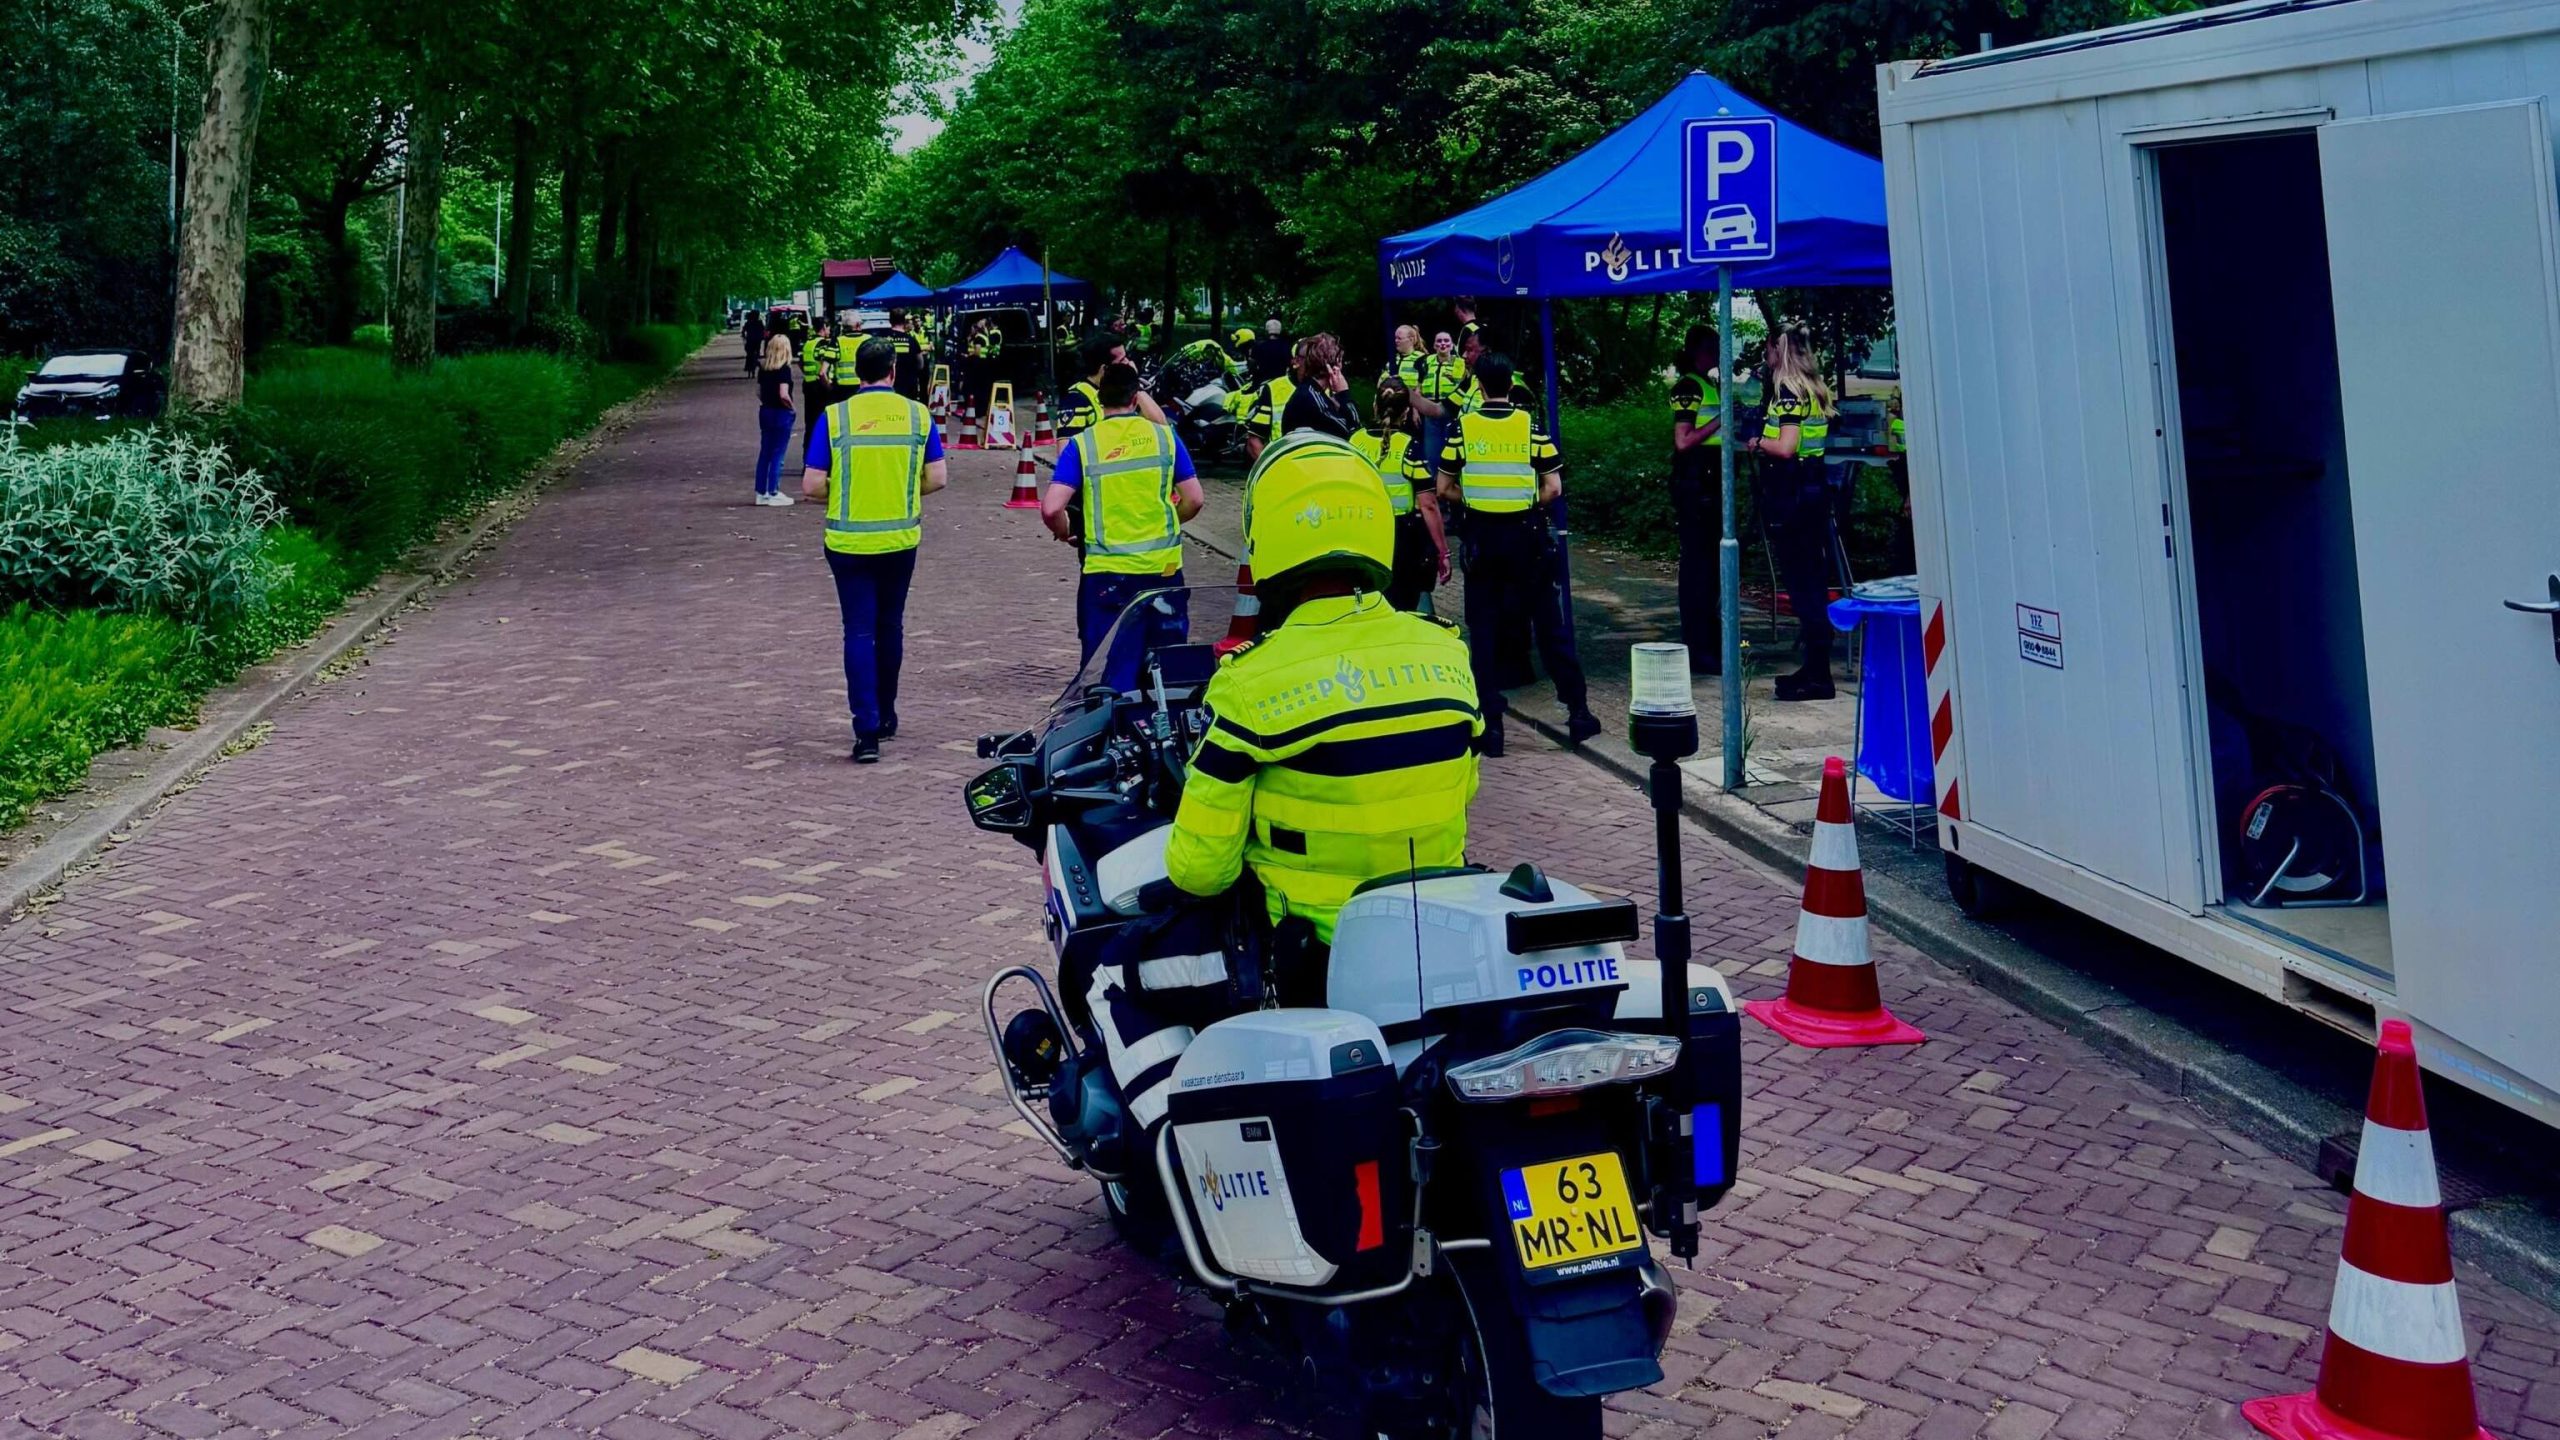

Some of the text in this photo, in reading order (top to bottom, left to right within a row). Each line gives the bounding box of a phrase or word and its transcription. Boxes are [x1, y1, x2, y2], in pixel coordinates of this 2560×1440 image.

[1707, 130, 1754, 200] P
[1585, 247, 1682, 281] POLIT
[998, 415, 1005, 426] 3
[1468, 441, 1528, 457] POLITIE
[1295, 504, 1375, 529] POLITIE
[1317, 662, 1448, 703] POLITIE
[1517, 958, 1620, 991] POLITIE
[1199, 1170, 1270, 1211] POLITIE
[1557, 1162, 1602, 1204] 63
[1512, 1199, 1528, 1212] NL
[1556, 1256, 1620, 1277] www.politie.nl
